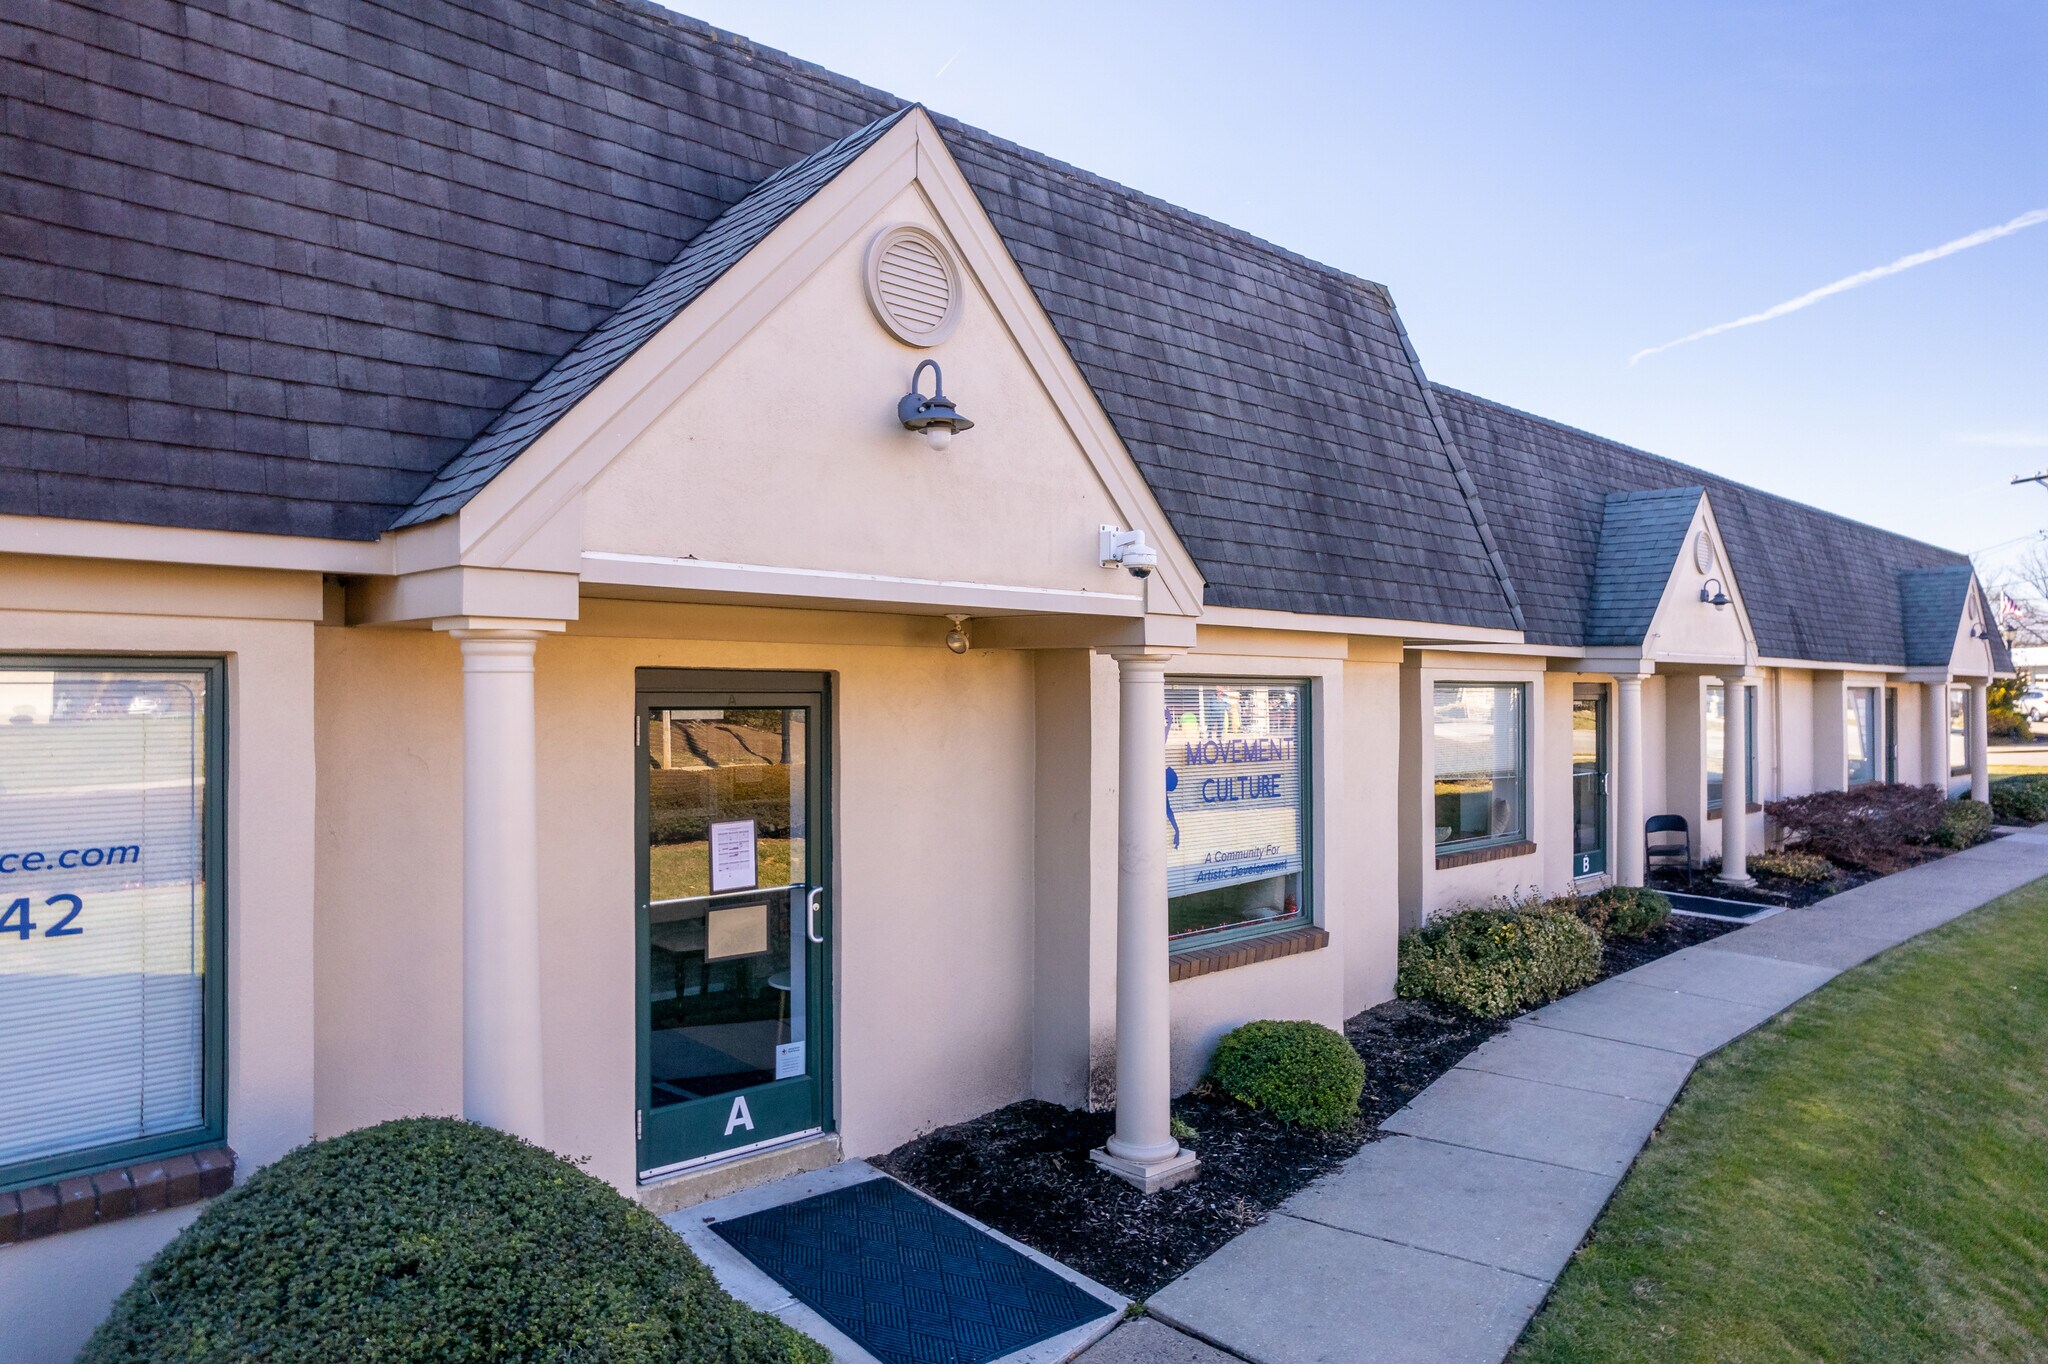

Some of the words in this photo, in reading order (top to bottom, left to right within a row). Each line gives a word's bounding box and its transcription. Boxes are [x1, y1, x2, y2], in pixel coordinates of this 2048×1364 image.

[1186, 738, 1294, 766] MOVEMENT
[1202, 773, 1282, 803] CULTURE
[0, 845, 140, 873] ce.com
[1204, 852, 1212, 864] A
[1214, 846, 1264, 863] Community
[1265, 844, 1280, 856] For
[1582, 856, 1590, 873] B
[1196, 867, 1230, 883] Artistic
[1230, 858, 1288, 878] Development
[0, 893, 84, 940] 42
[724, 1095, 755, 1136] A
